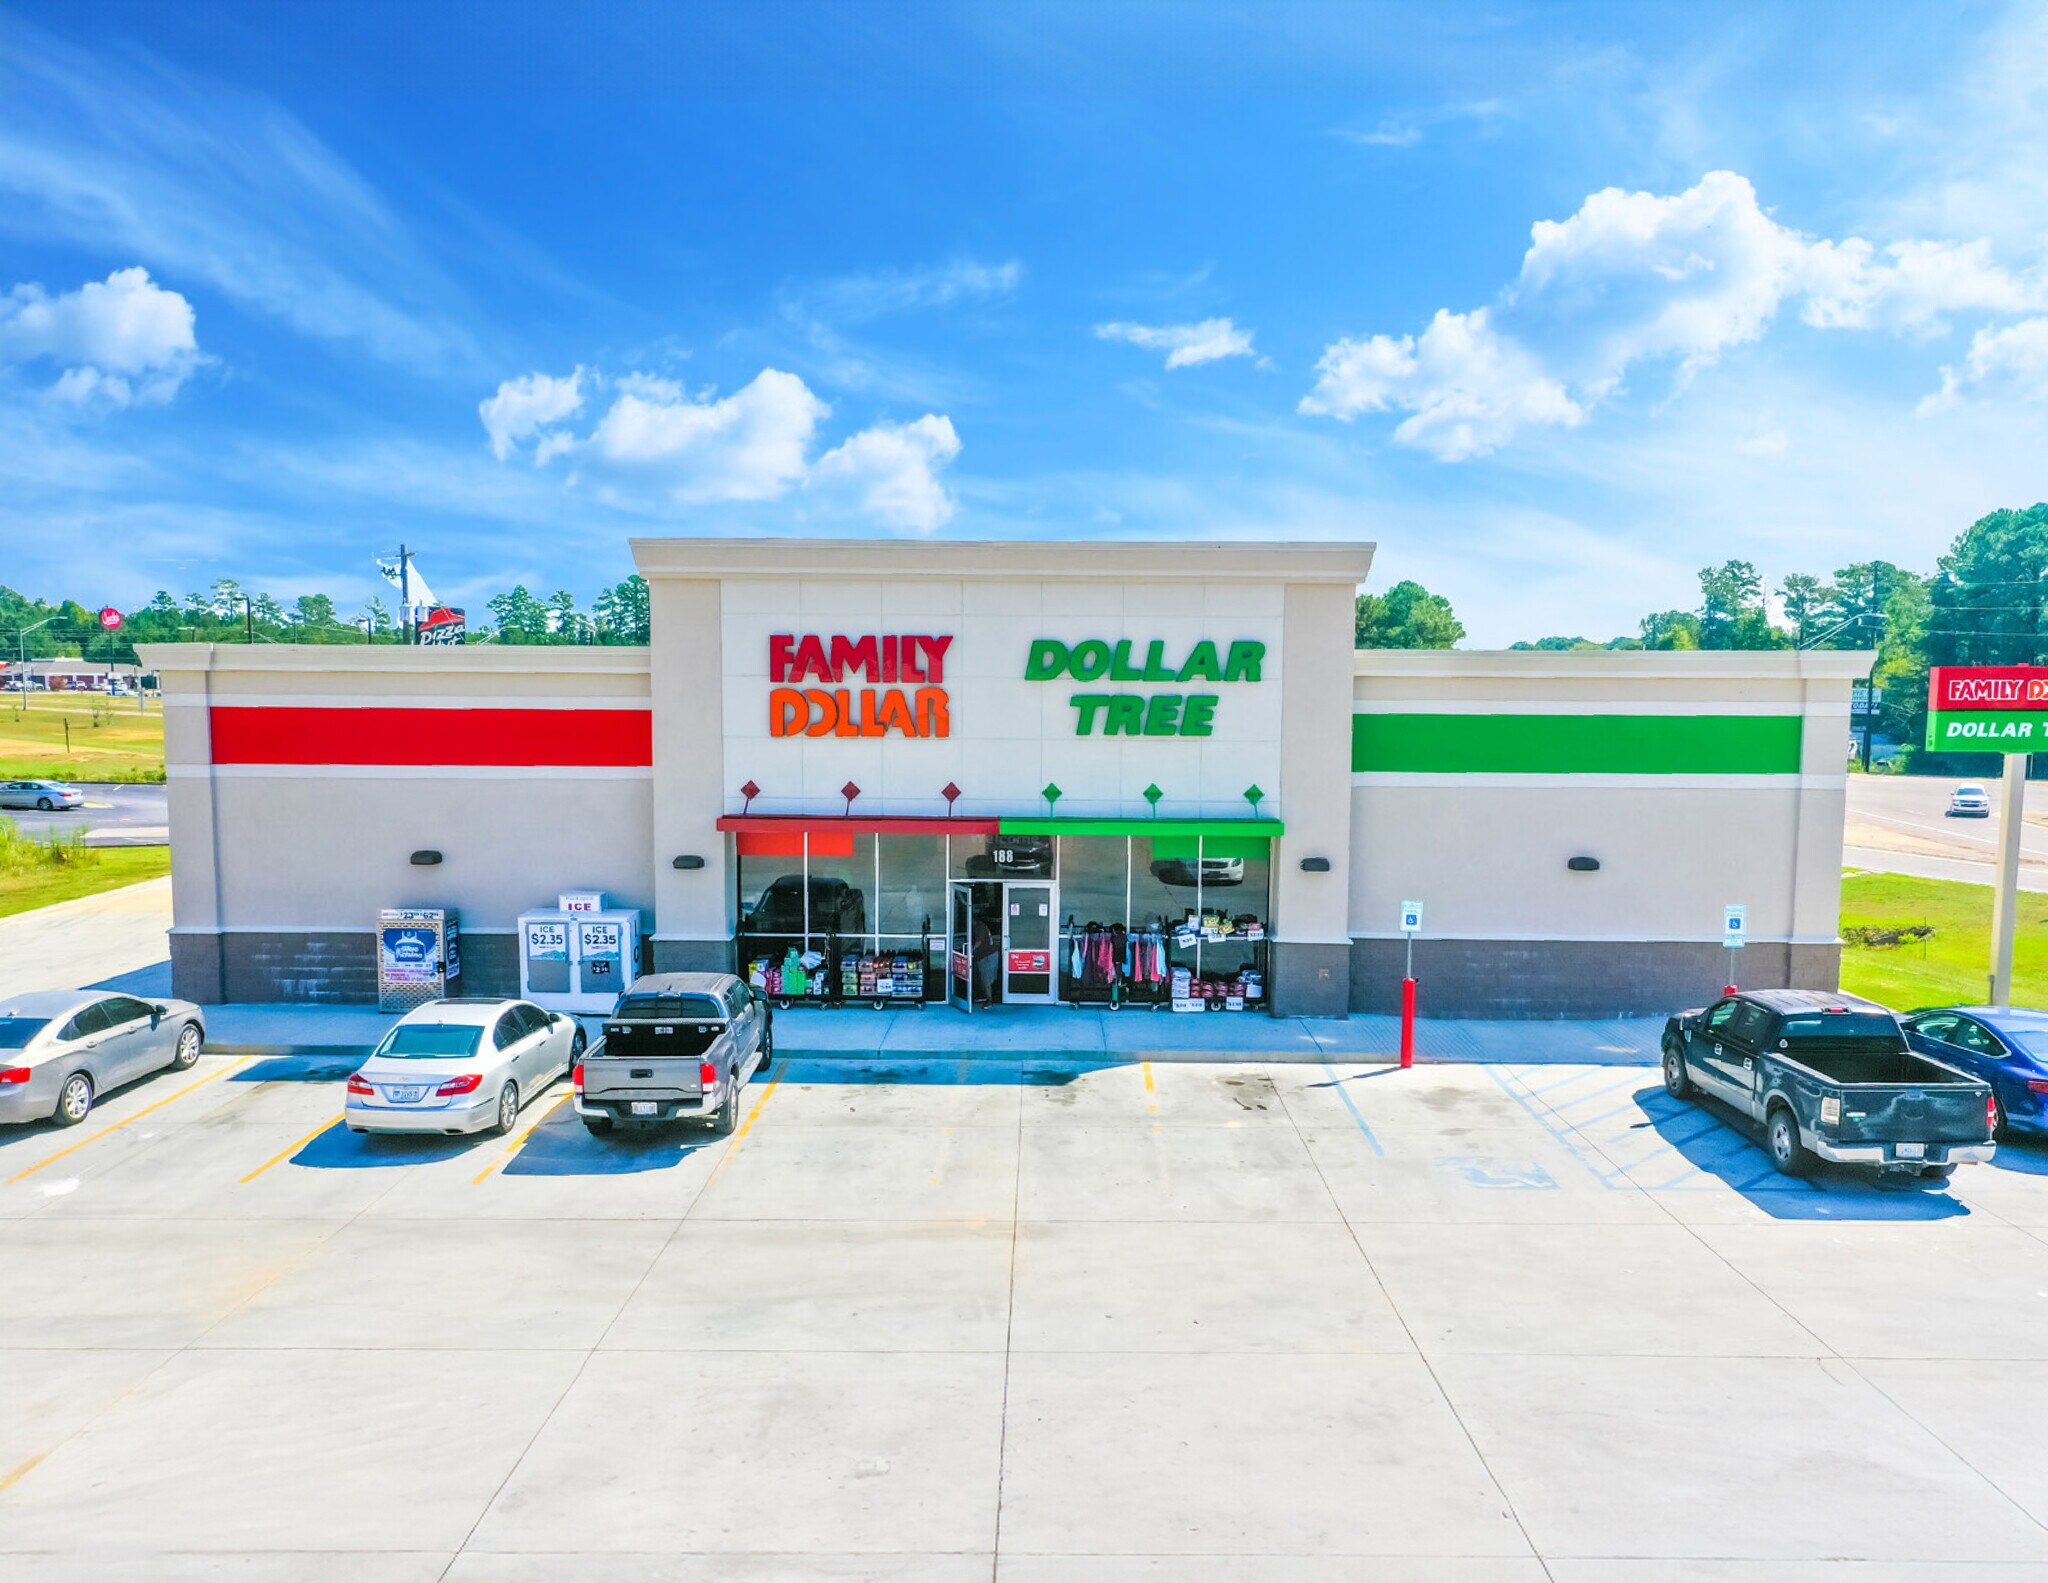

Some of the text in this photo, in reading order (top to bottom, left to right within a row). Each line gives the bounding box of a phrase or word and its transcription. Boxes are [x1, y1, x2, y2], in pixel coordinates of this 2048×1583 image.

[420, 624, 465, 646] Pizza
[769, 635, 954, 683] FAMILY
[1024, 639, 1266, 682] DOLLAR
[1948, 679, 2024, 701] FAMILY
[769, 687, 950, 737] DOLLAR
[1069, 694, 1219, 737] TREE
[1946, 722, 2033, 737] DOLLAR
[993, 850, 1014, 862] 188
[568, 903, 592, 911] ICE
[531, 933, 563, 945] $2.35
[584, 933, 617, 945] $2.35
[592, 926, 608, 934] ICE
